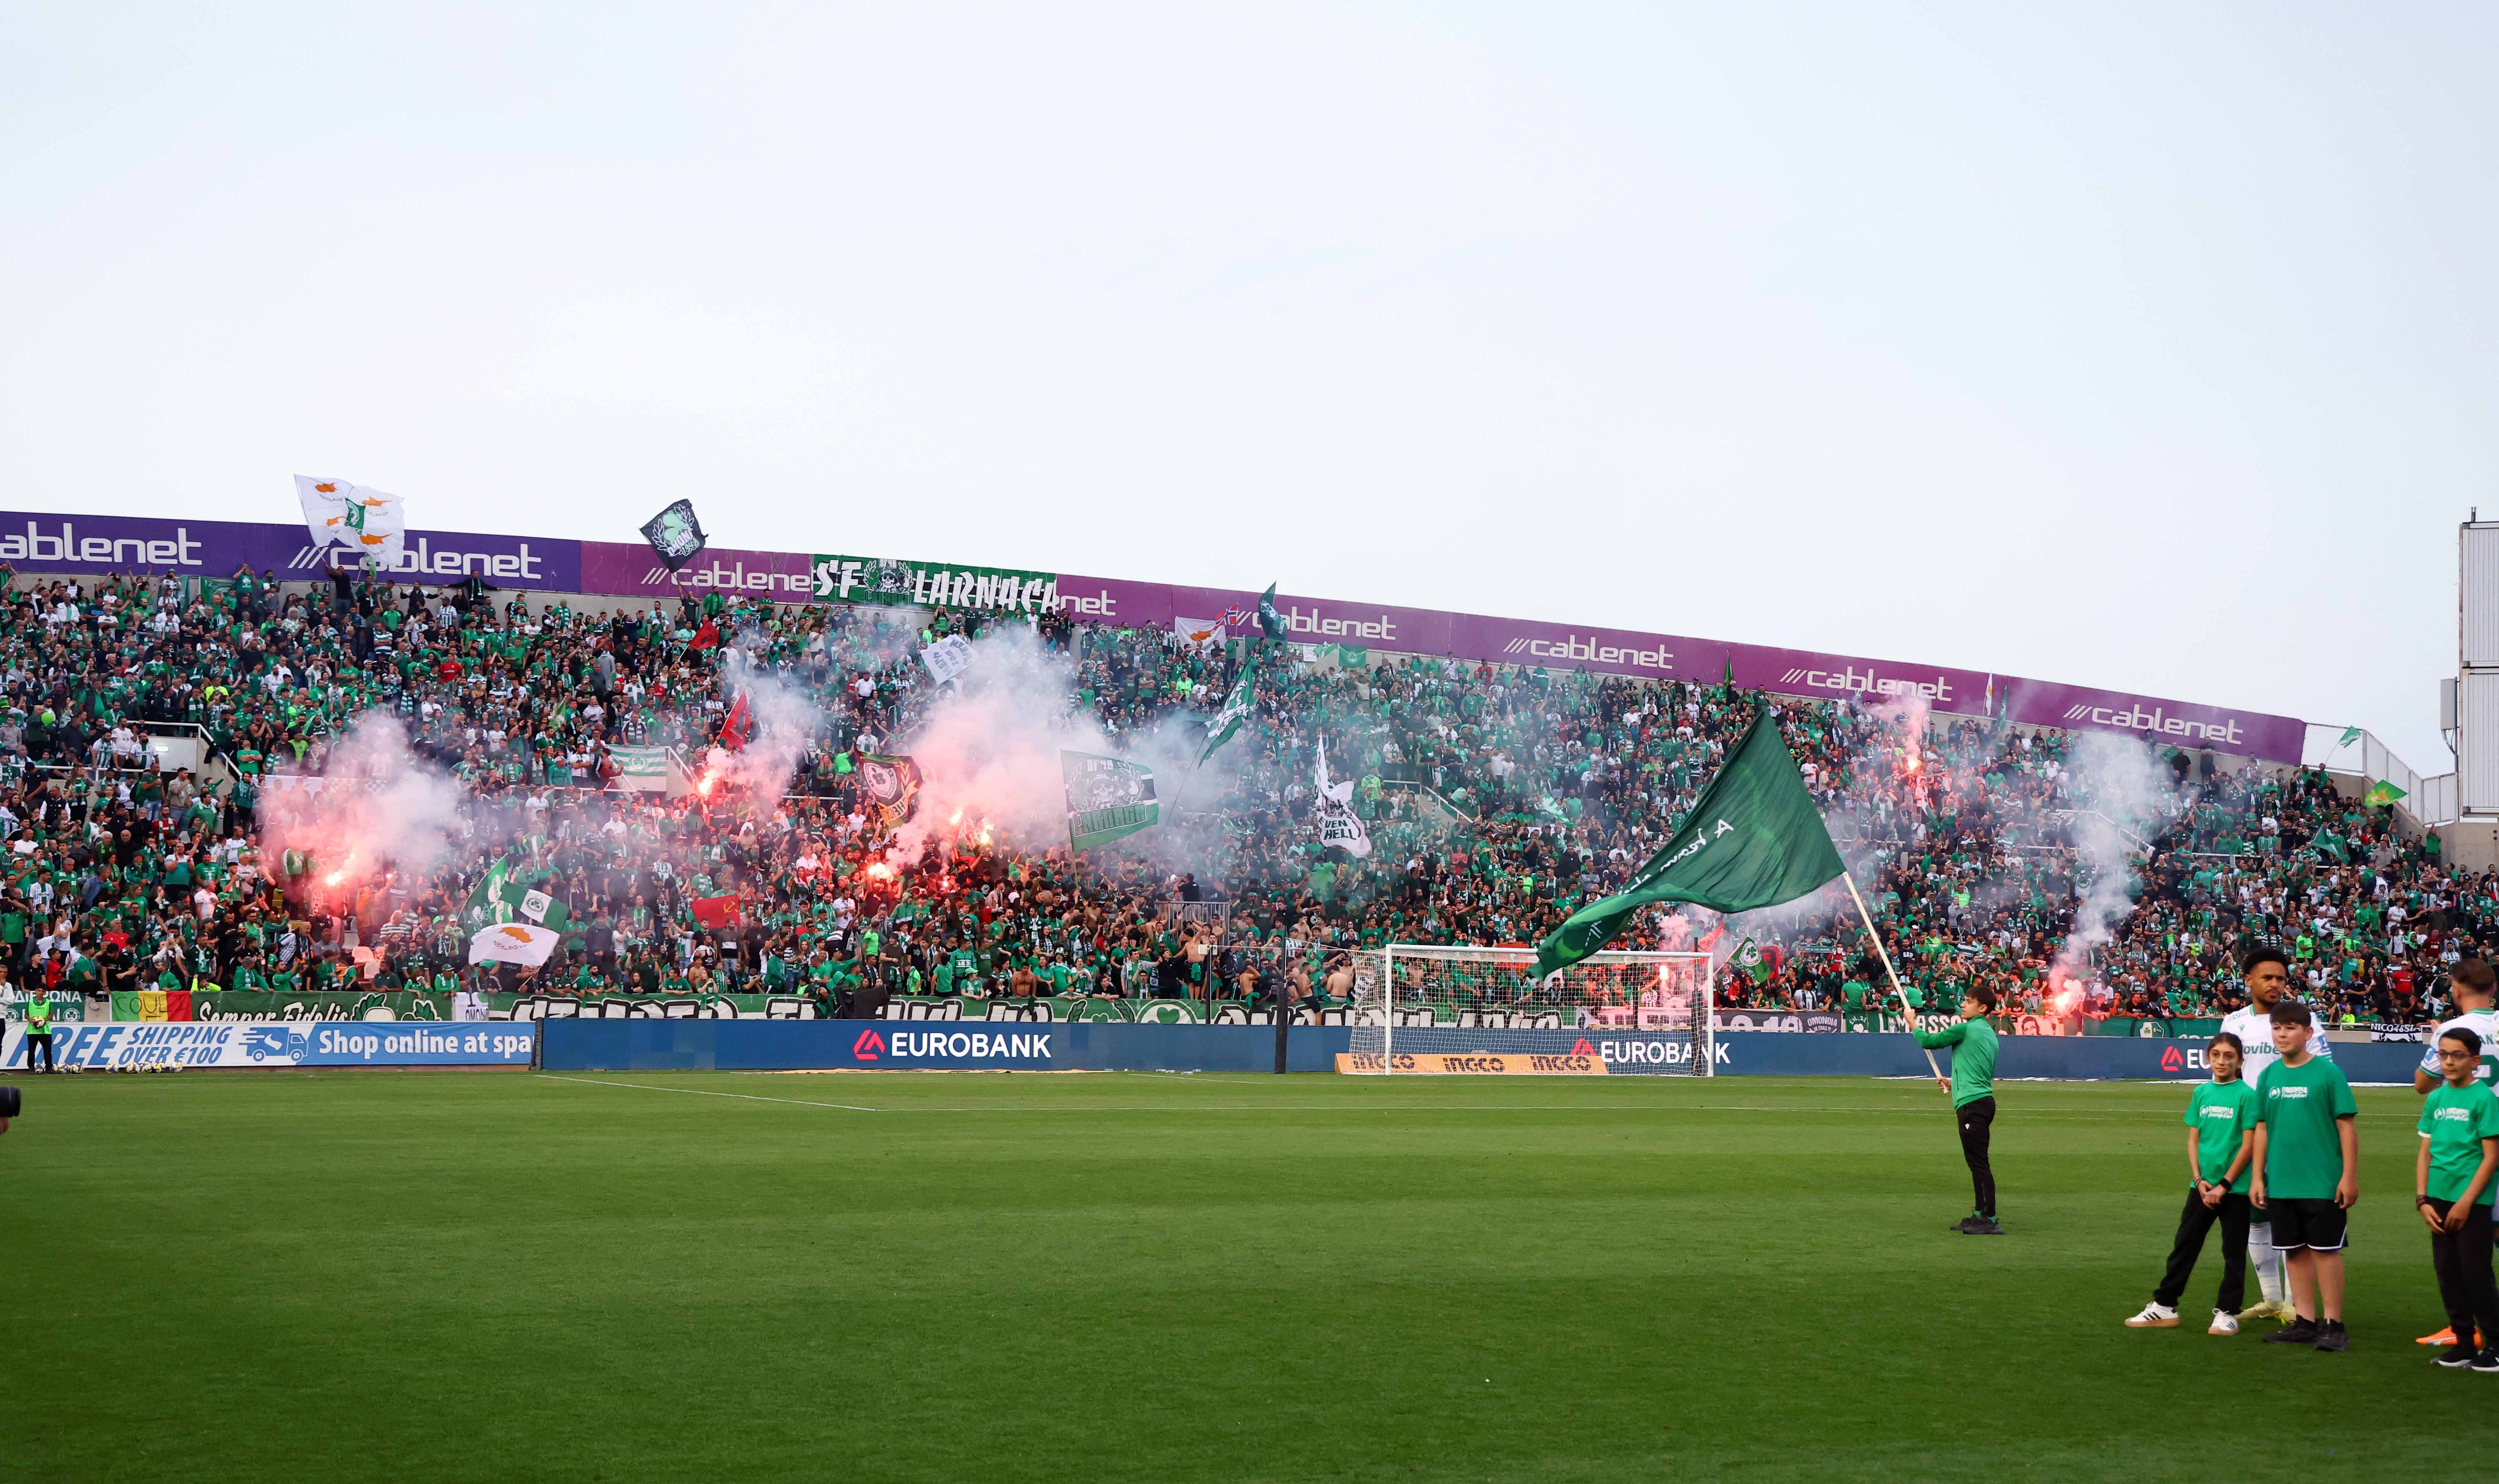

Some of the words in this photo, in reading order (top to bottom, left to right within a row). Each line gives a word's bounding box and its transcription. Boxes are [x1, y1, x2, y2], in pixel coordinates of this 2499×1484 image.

[671, 561, 812, 592] cablene
[814, 559, 862, 598] SF
[913, 569, 1057, 615] LARNACA
[1530, 635, 1673, 669] cablenet
[1807, 666, 1953, 702] cablenet
[2092, 704, 2243, 745] cablenet
[1319, 816, 1348, 828] EVEN
[1324, 828, 1357, 840] HELL
[1807, 1016, 1838, 1027] OMONOIA
[127, 1026, 233, 1045] SHIPPING
[319, 1030, 378, 1059] Shop
[385, 1030, 458, 1053] online
[464, 1032, 488, 1053] at
[493, 1036, 534, 1059] spa
[892, 1032, 1052, 1058] EUROBANK
[2243, 1042, 2280, 1055] ovibe
[119, 1047, 172, 1065] OVER
[174, 1047, 222, 1064] €100
